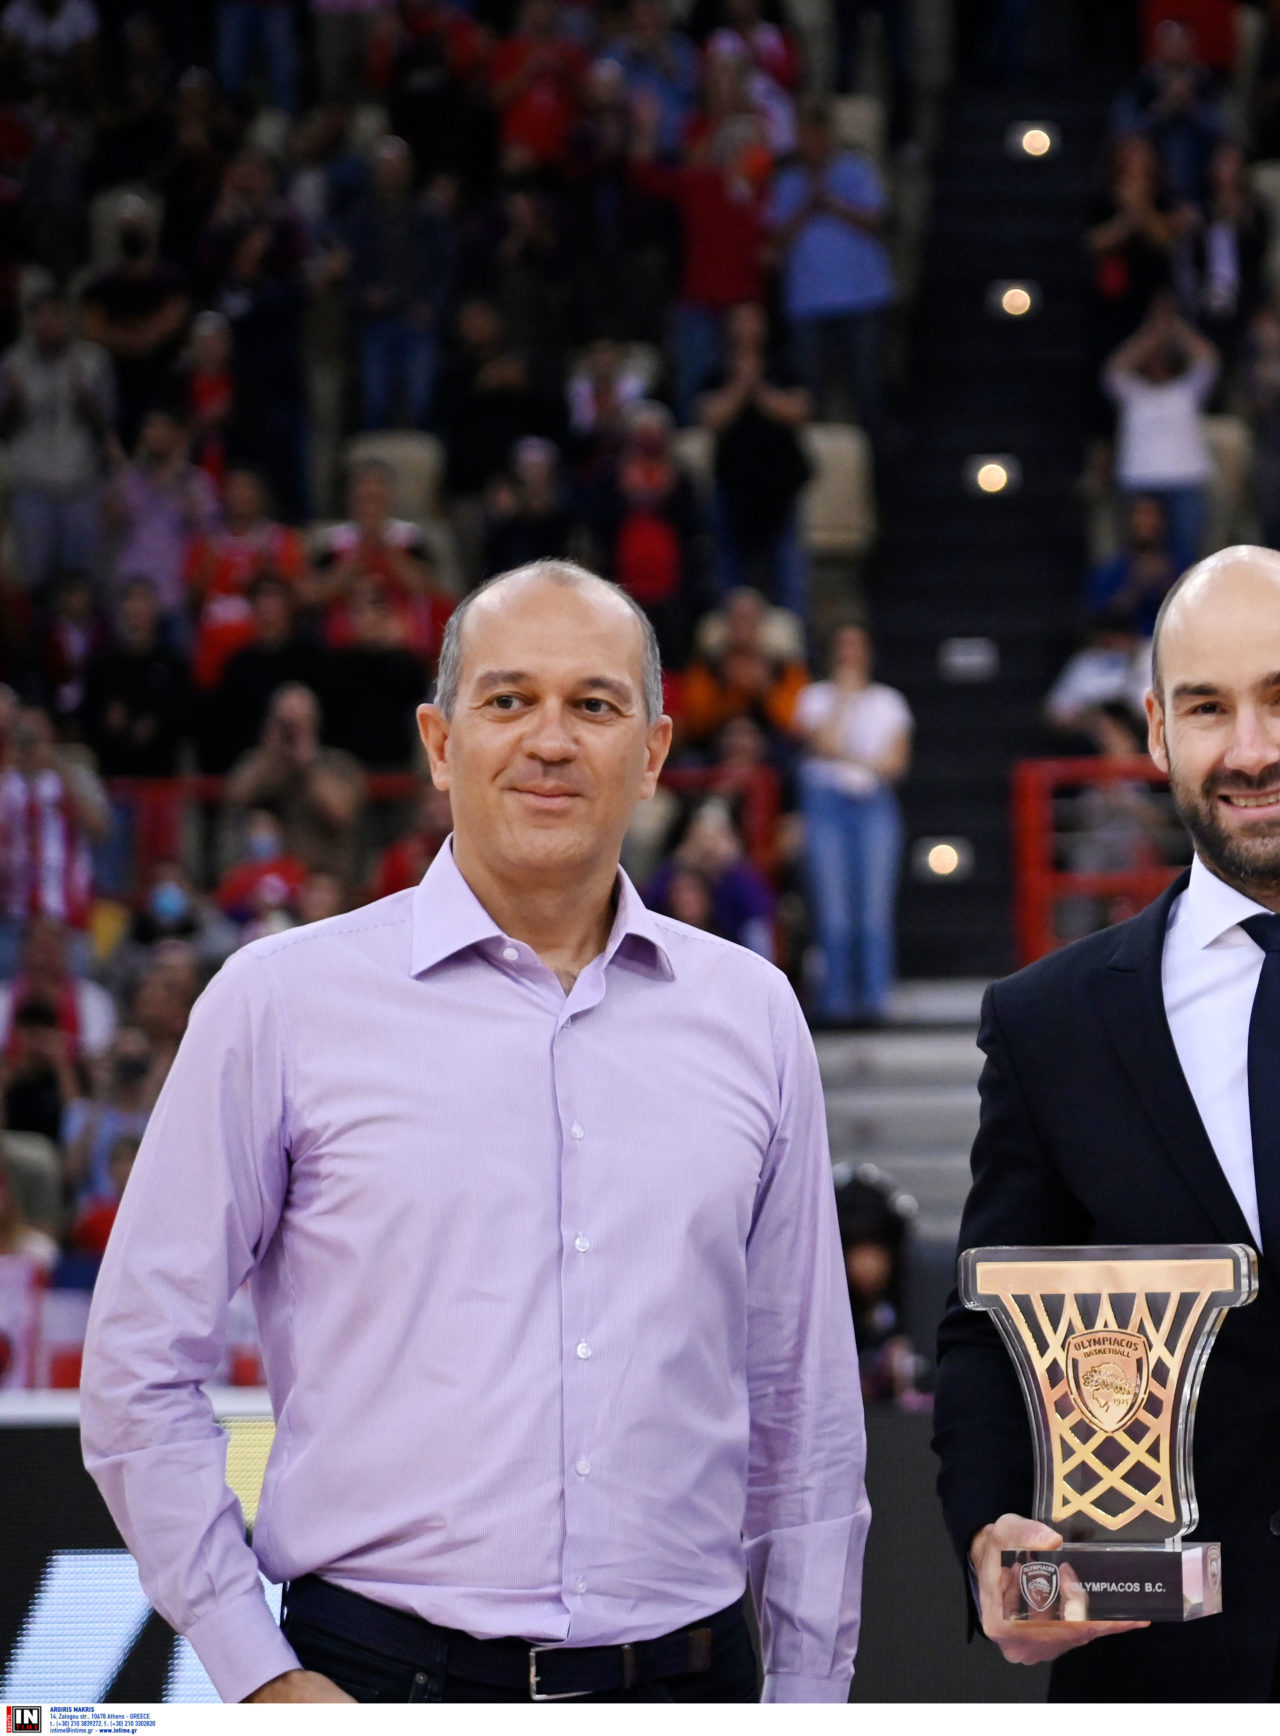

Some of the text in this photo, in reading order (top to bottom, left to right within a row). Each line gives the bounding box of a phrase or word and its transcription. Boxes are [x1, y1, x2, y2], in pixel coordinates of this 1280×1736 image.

[1074, 1337, 1139, 1352] OLYMPIACOS
[1084, 1347, 1131, 1359] BASKETBALL
[1072, 1582, 1167, 1593] OLYMPIACOS B.C.
